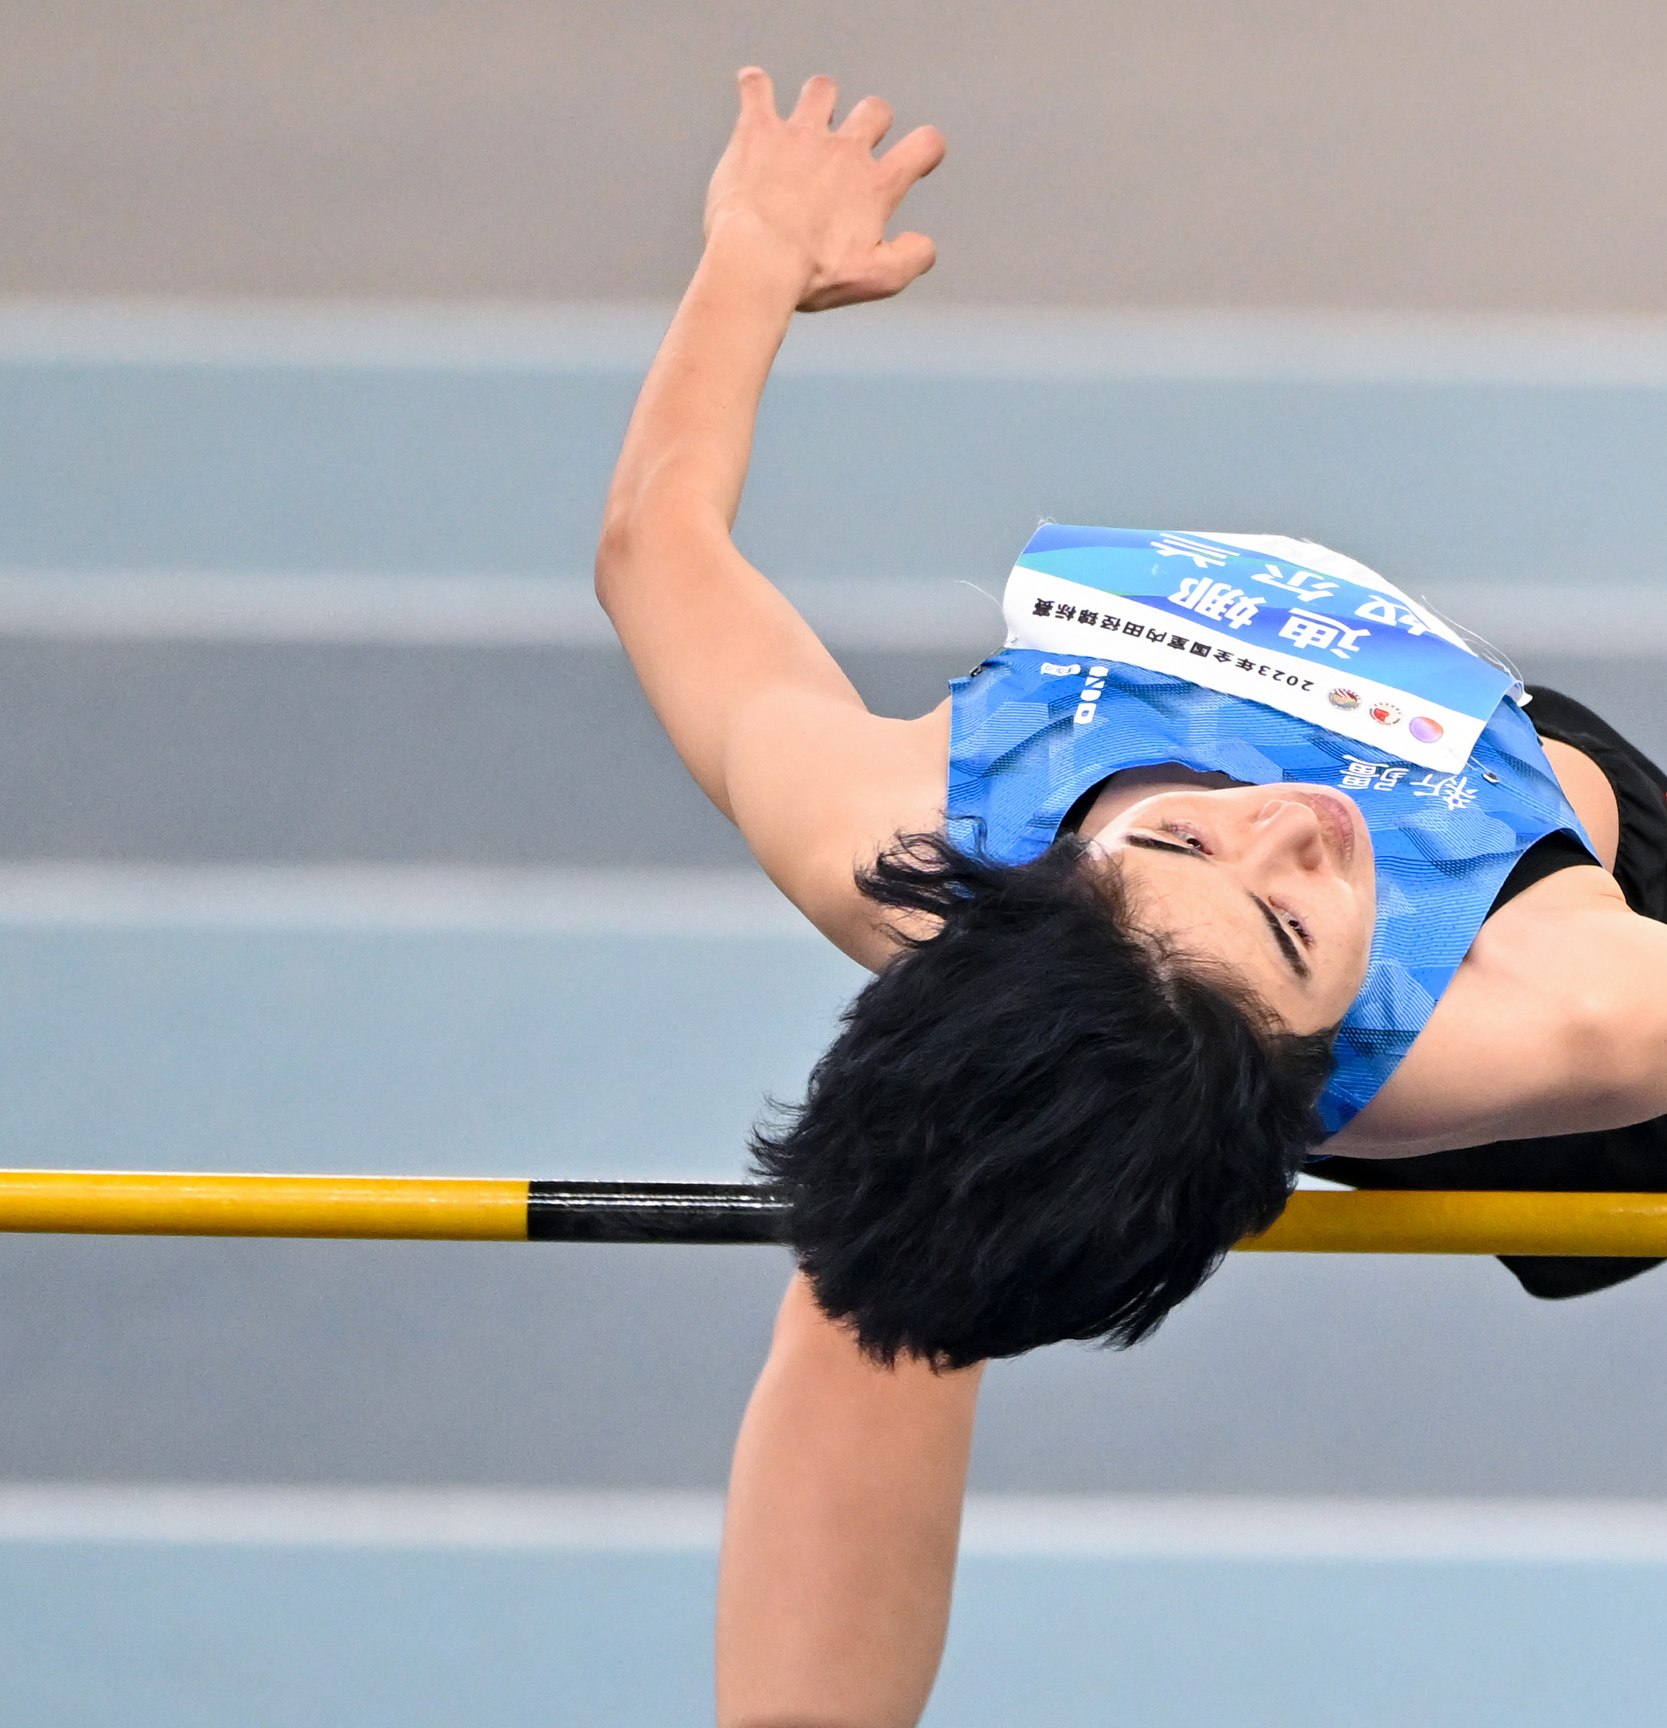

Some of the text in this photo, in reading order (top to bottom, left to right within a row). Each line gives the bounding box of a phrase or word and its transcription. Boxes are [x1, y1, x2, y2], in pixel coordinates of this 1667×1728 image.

[1032, 597, 1313, 692] 2023年全国室内田径锦标赛
[1167, 576, 1371, 660] 迪娜
[1337, 754, 1481, 811] 新疆
